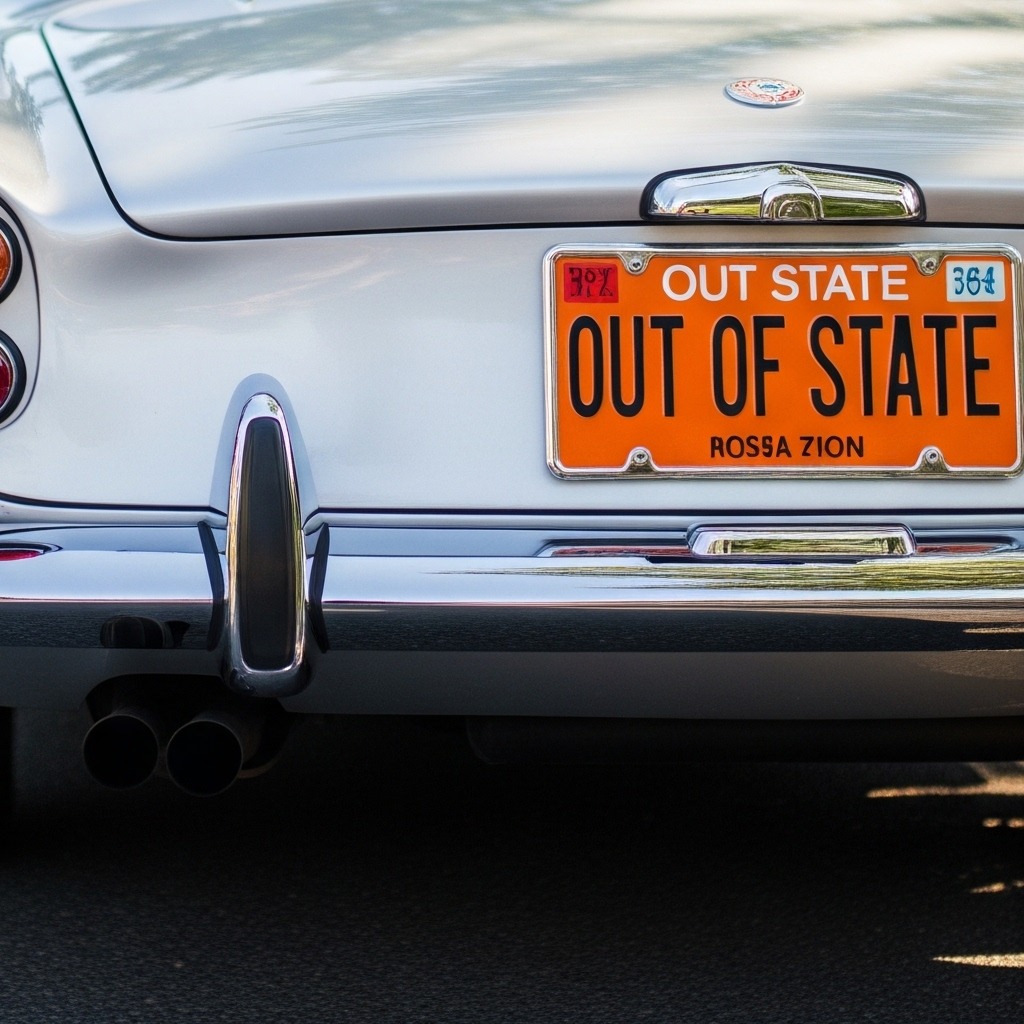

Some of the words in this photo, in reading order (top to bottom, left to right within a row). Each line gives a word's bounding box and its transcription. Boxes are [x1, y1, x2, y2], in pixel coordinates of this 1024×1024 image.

[663, 265, 756, 301] OUT
[772, 265, 908, 301] STATE
[569, 315, 684, 417] OUT
[713, 315, 785, 417] OF
[809, 315, 1000, 417] STATE
[710, 435, 792, 458] ROSSA
[800, 435, 864, 458] ZION
